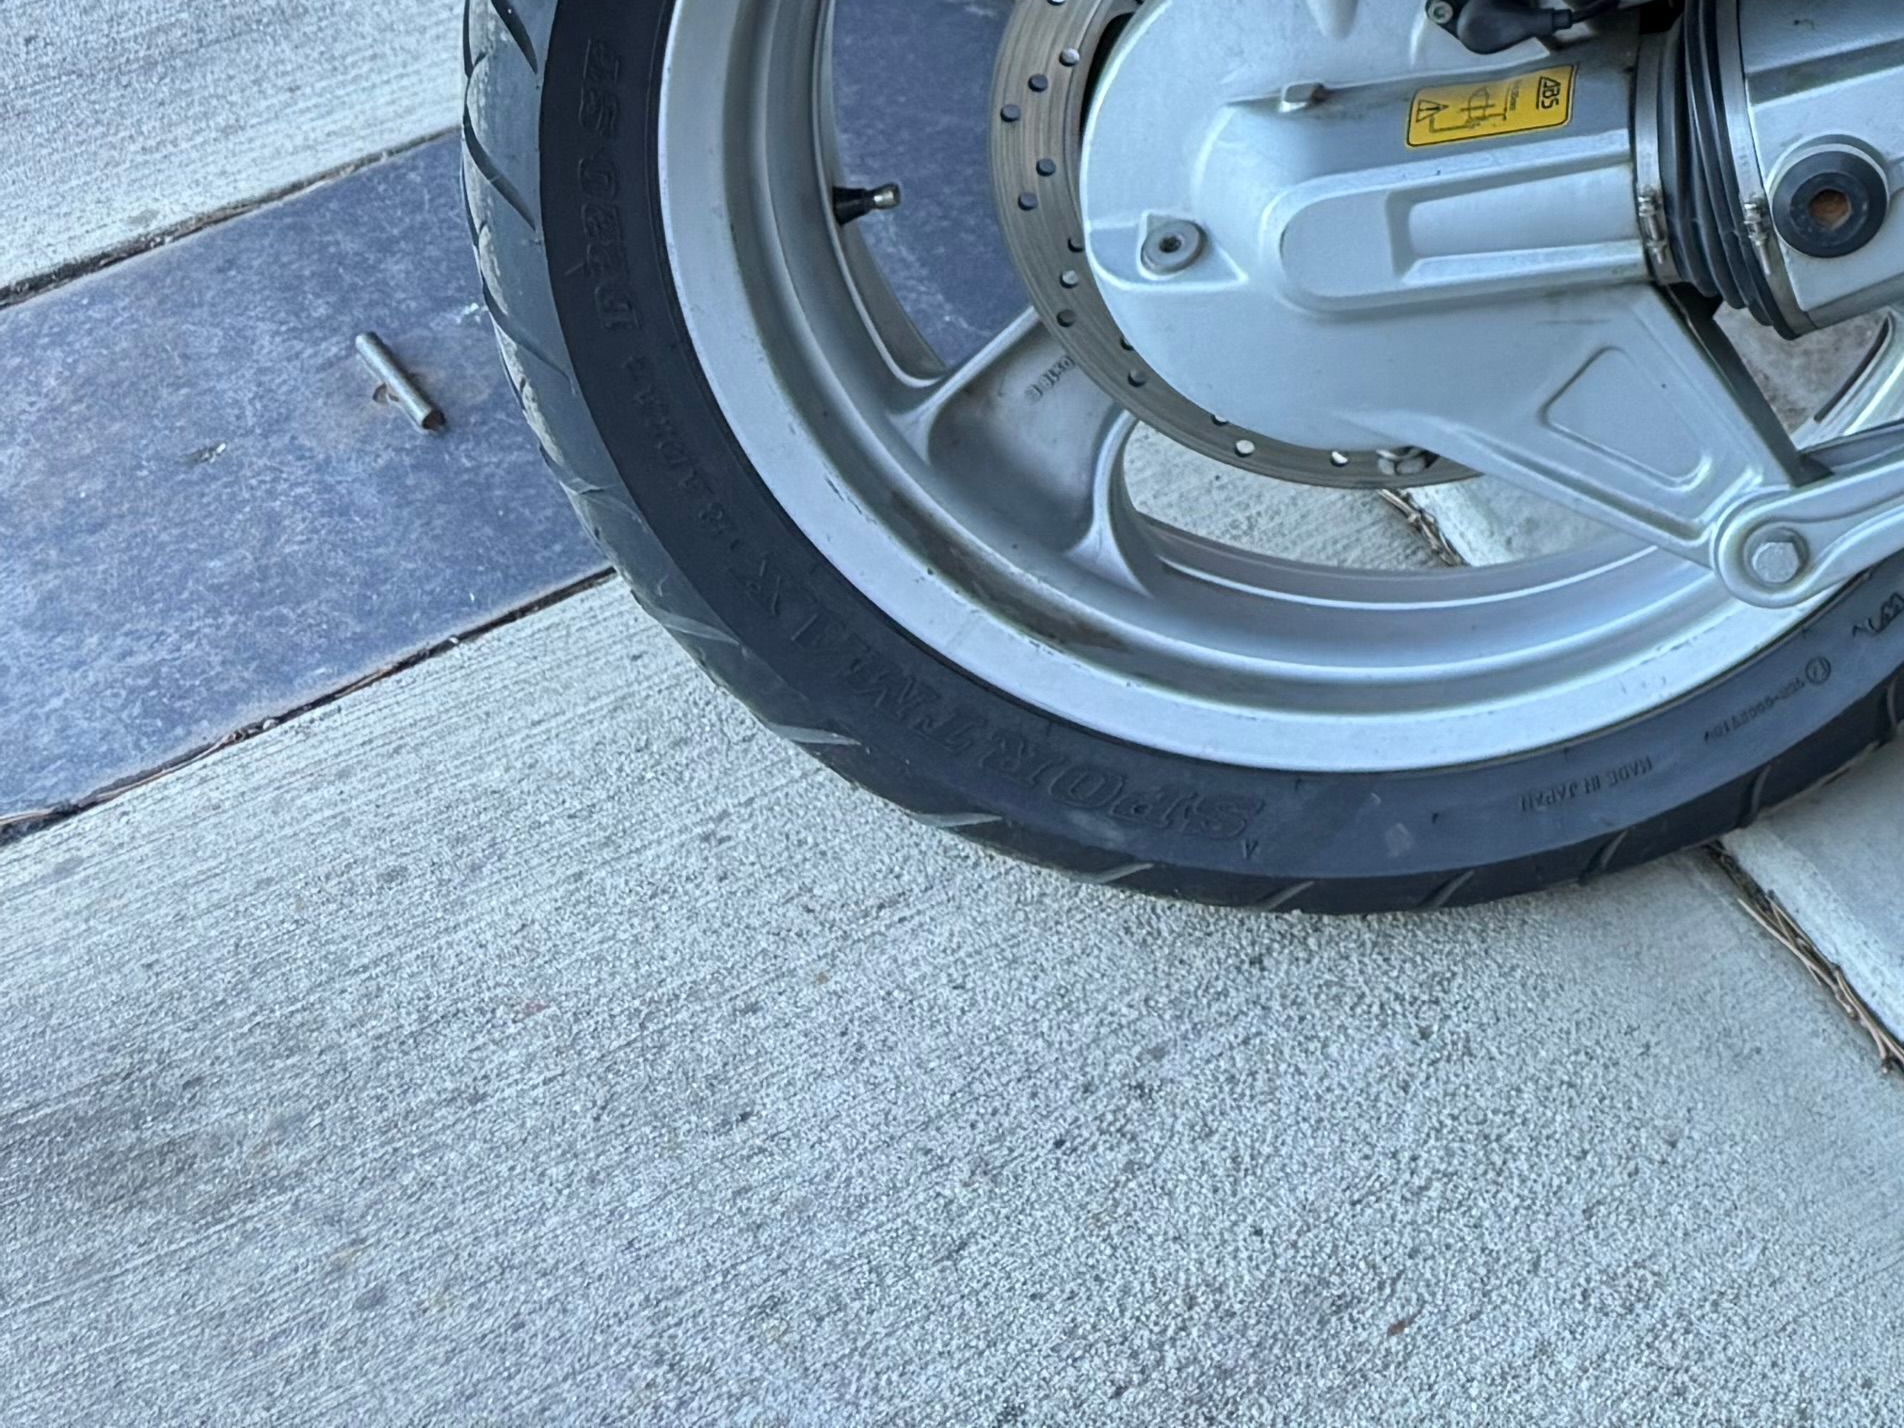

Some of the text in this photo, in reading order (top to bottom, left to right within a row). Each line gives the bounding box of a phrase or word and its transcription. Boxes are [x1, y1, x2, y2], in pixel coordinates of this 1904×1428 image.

[741, 558, 1264, 840] SPORTMAX
[1518, 754, 1653, 813] MADE IN JAPAN
